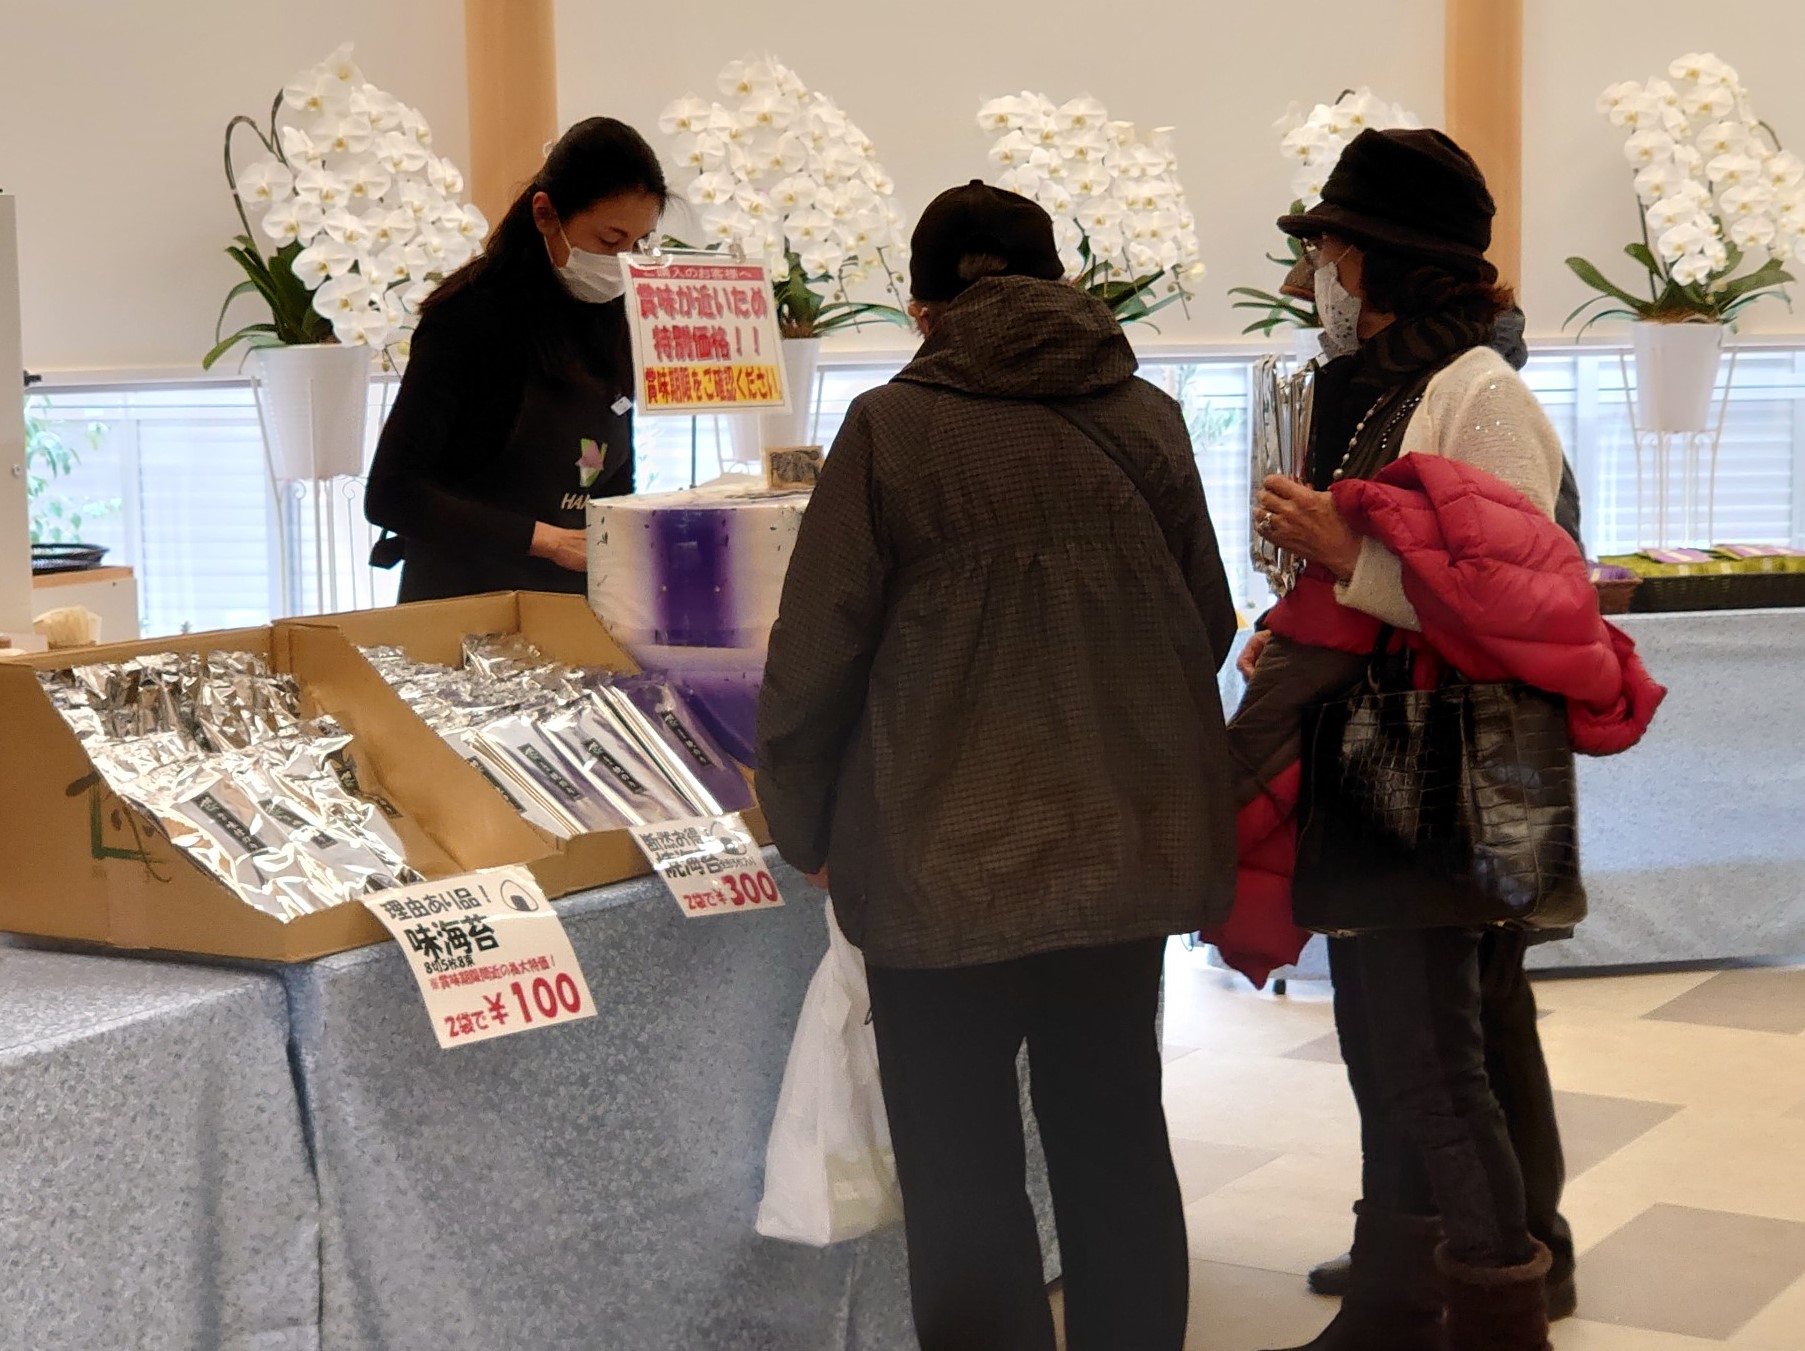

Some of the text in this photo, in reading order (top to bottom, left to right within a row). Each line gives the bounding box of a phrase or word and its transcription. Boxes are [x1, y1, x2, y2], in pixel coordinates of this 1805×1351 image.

[636, 282, 768, 320] 賞味が近いため
[651, 323, 762, 362] 特別価格！！
[644, 366, 781, 404] 賞味期限をご確認ください
[380, 884, 492, 922] 理由あり品！
[403, 913, 500, 960] 味海苔
